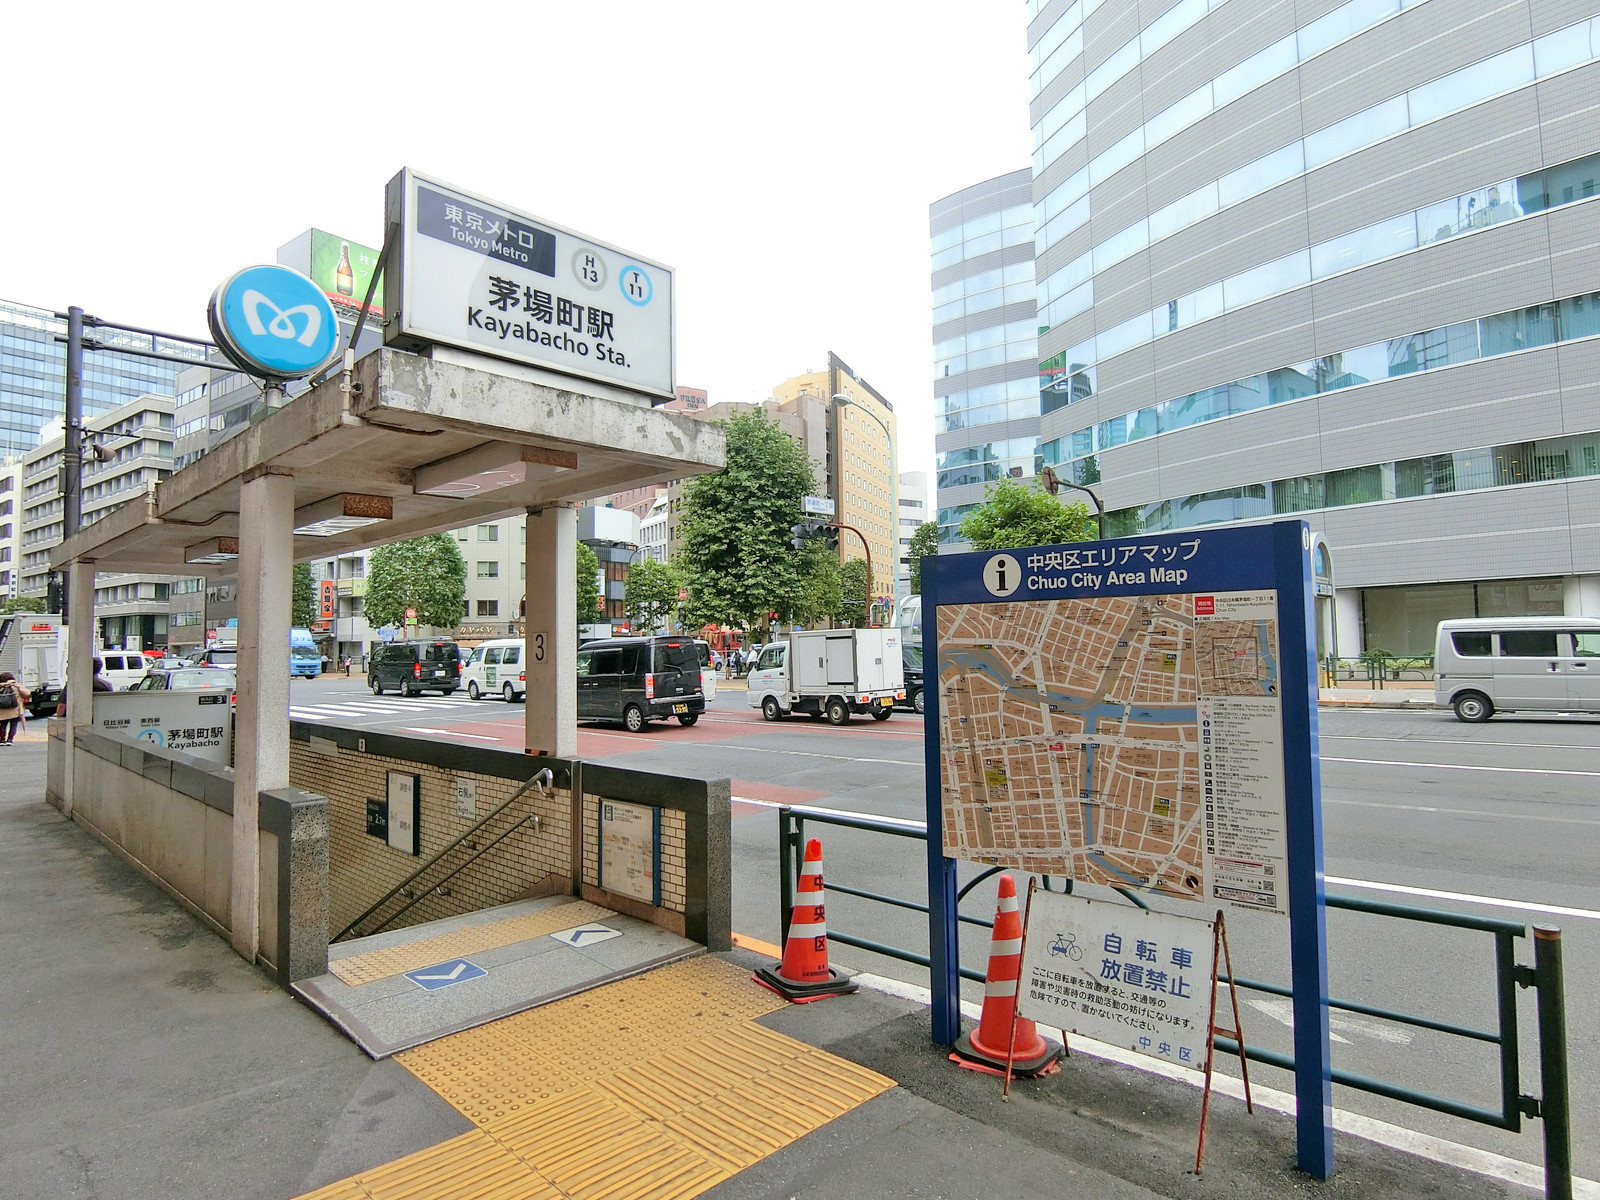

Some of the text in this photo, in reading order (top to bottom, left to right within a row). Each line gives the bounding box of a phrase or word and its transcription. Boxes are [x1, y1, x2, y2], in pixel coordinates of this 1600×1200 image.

[444, 202, 534, 249] 東京メトロ
[450, 225, 529, 263] Tokyo Metro
[582, 267, 598, 283] 13
[585, 254, 595, 268] H
[629, 283, 643, 298] 11
[633, 272, 640, 284] T
[488, 275, 614, 342] 茅場町駅
[468, 306, 631, 368] Kayabacho Sta.
[1027, 538, 1201, 572] 中央区エリアマップ
[1027, 567, 1188, 590] Chuo City Area Map
[535, 633, 544, 661] 3
[216, 695, 223, 704] 3
[167, 726, 224, 742] 茅場町駅
[167, 738, 220, 751] Kayabacho
[813, 873, 827, 953] 中央区
[1103, 932, 1193, 970] 自転車
[1032, 966, 1167, 1009] ここに自転車を放置すると、交通等の
[1100, 958, 1191, 999] 放置禁止
[1029, 989, 1160, 1034] 危険ですので、置かないでください。
[1138, 1035, 1193, 1063] 中央区
